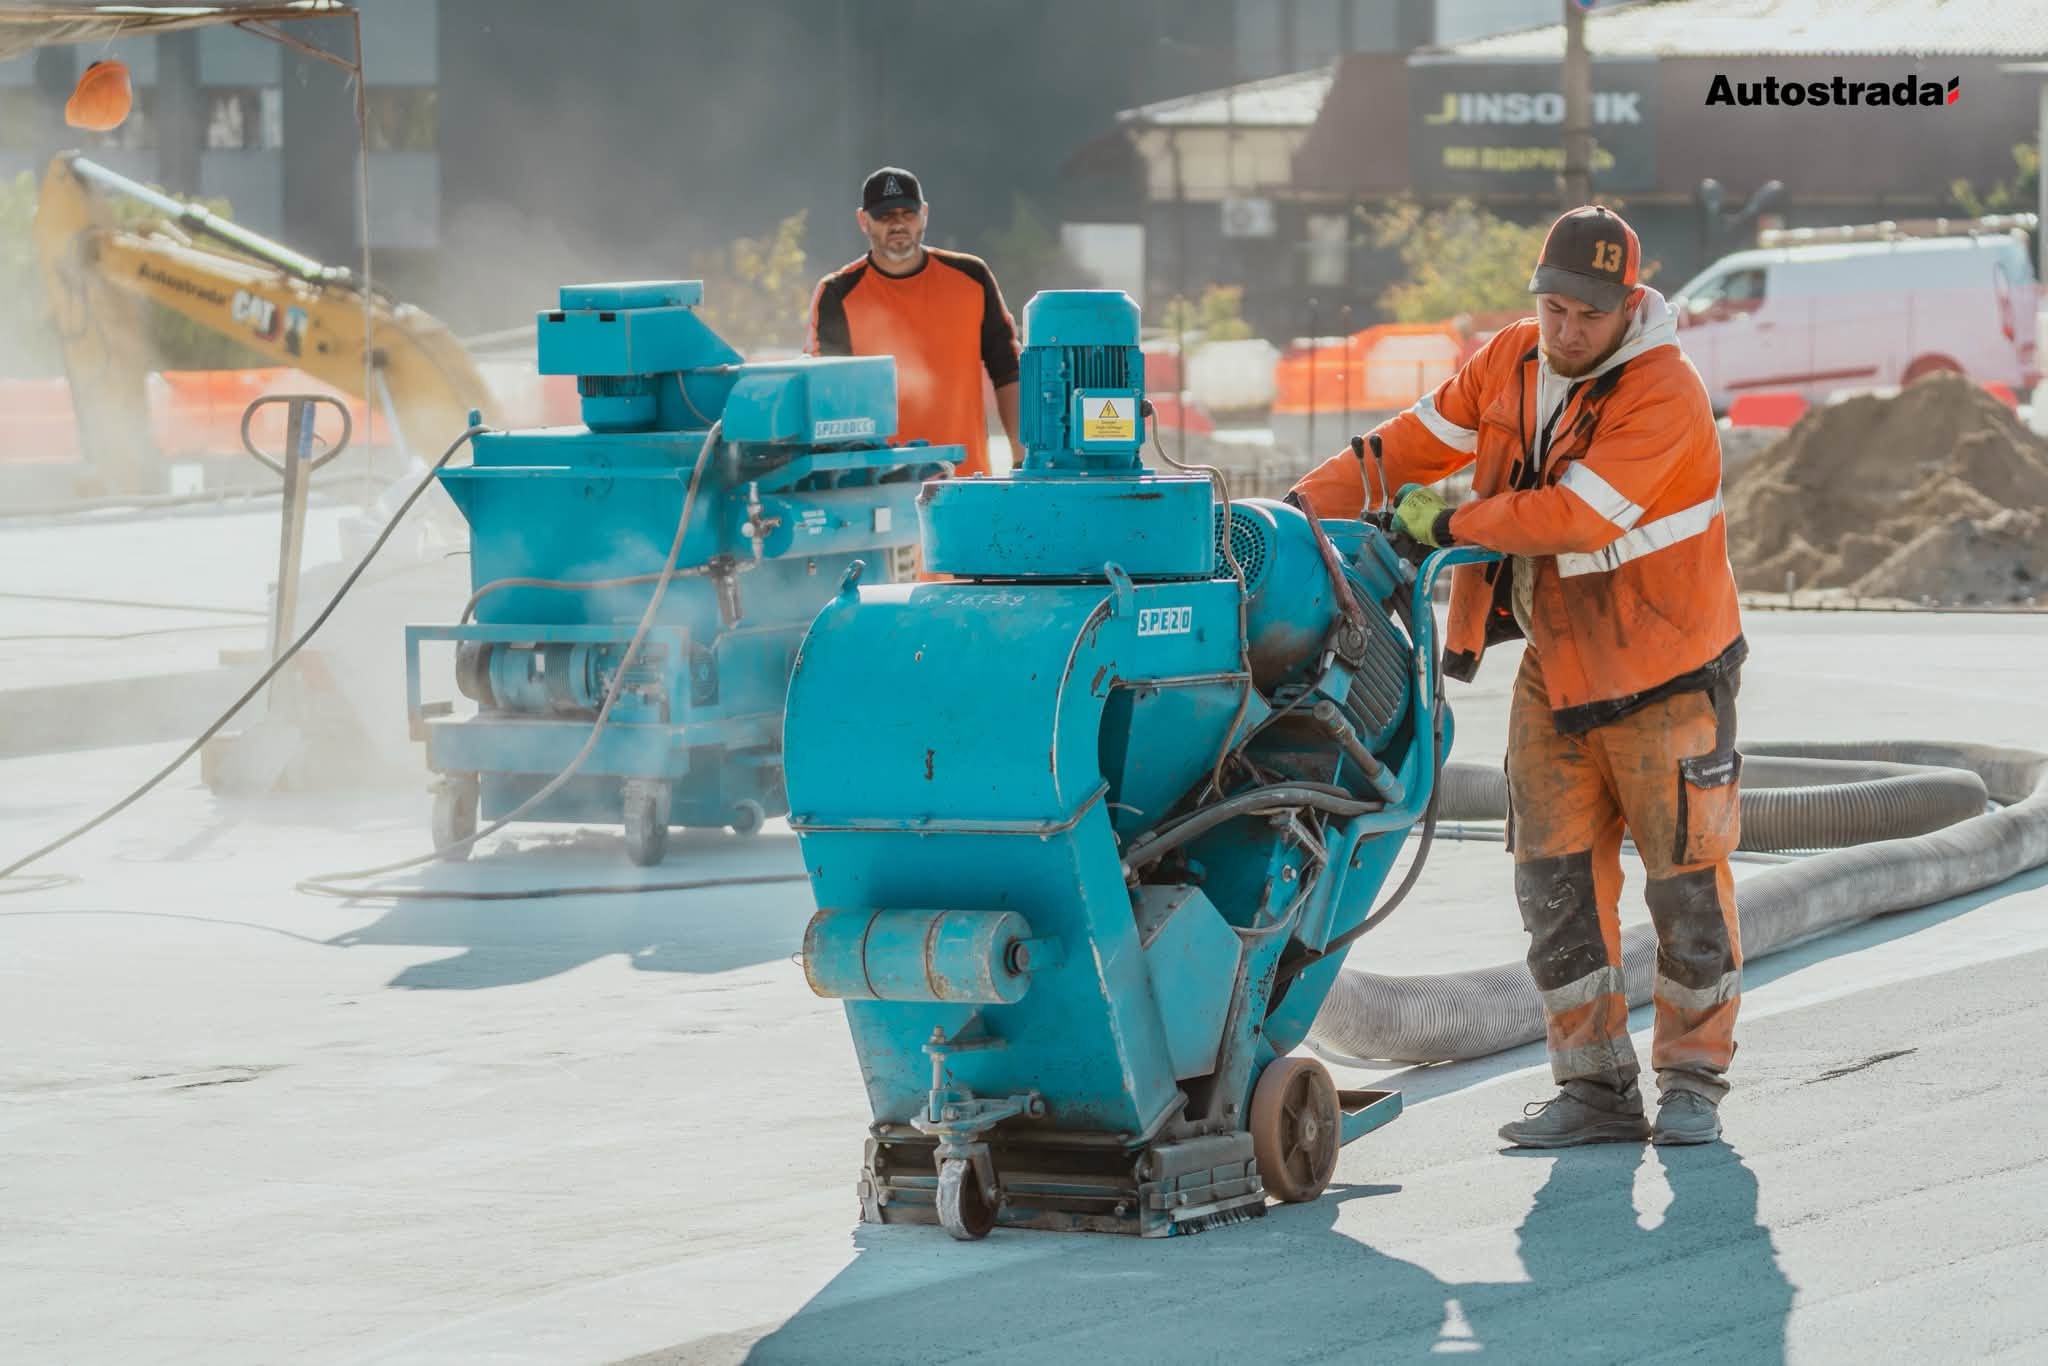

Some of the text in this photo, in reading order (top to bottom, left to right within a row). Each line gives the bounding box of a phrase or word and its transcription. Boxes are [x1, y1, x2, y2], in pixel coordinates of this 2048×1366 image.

[1424, 92, 1641, 124] JINSOIK
[1592, 240, 1622, 272] 13
[231, 288, 277, 336] CAT
[1140, 610, 1190, 631] SPE20
